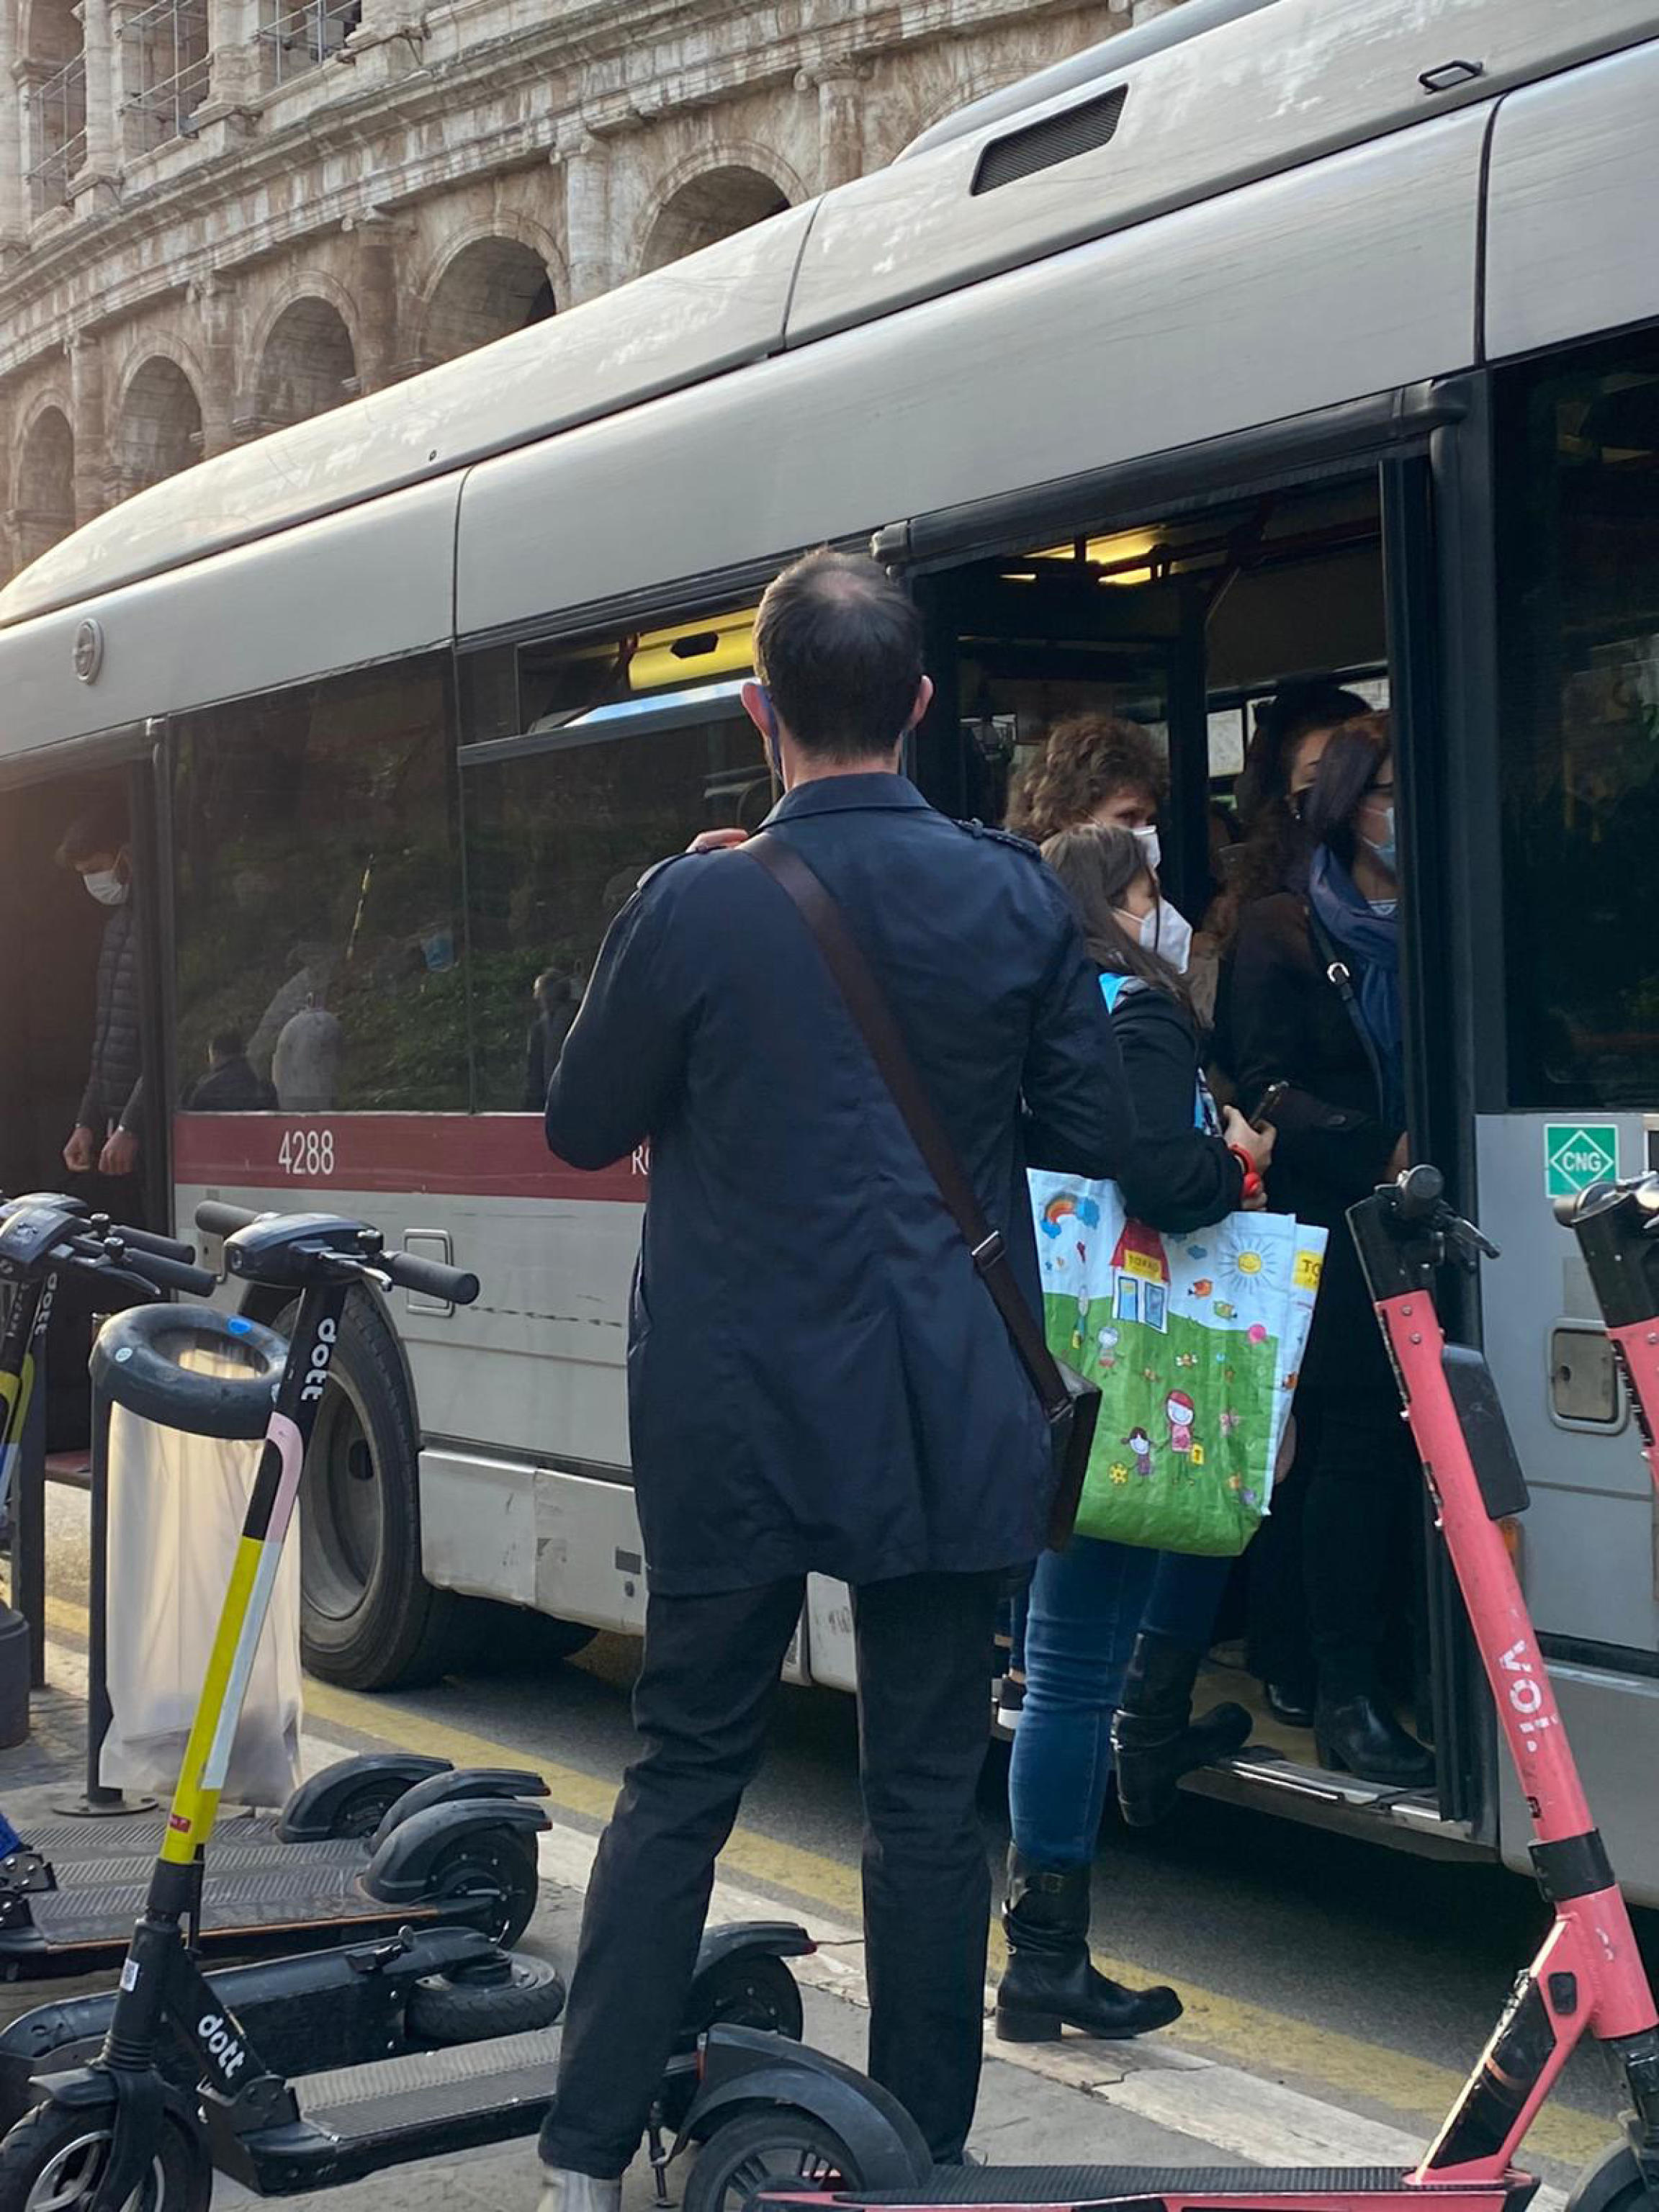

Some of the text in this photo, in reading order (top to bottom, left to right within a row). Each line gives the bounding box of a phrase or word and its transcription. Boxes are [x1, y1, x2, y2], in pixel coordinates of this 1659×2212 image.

[279, 1130, 334, 1175] 4288
[1563, 1151, 1602, 1172] CNG
[301, 1318, 337, 1401] dott
[198, 2014, 245, 2079] dott
